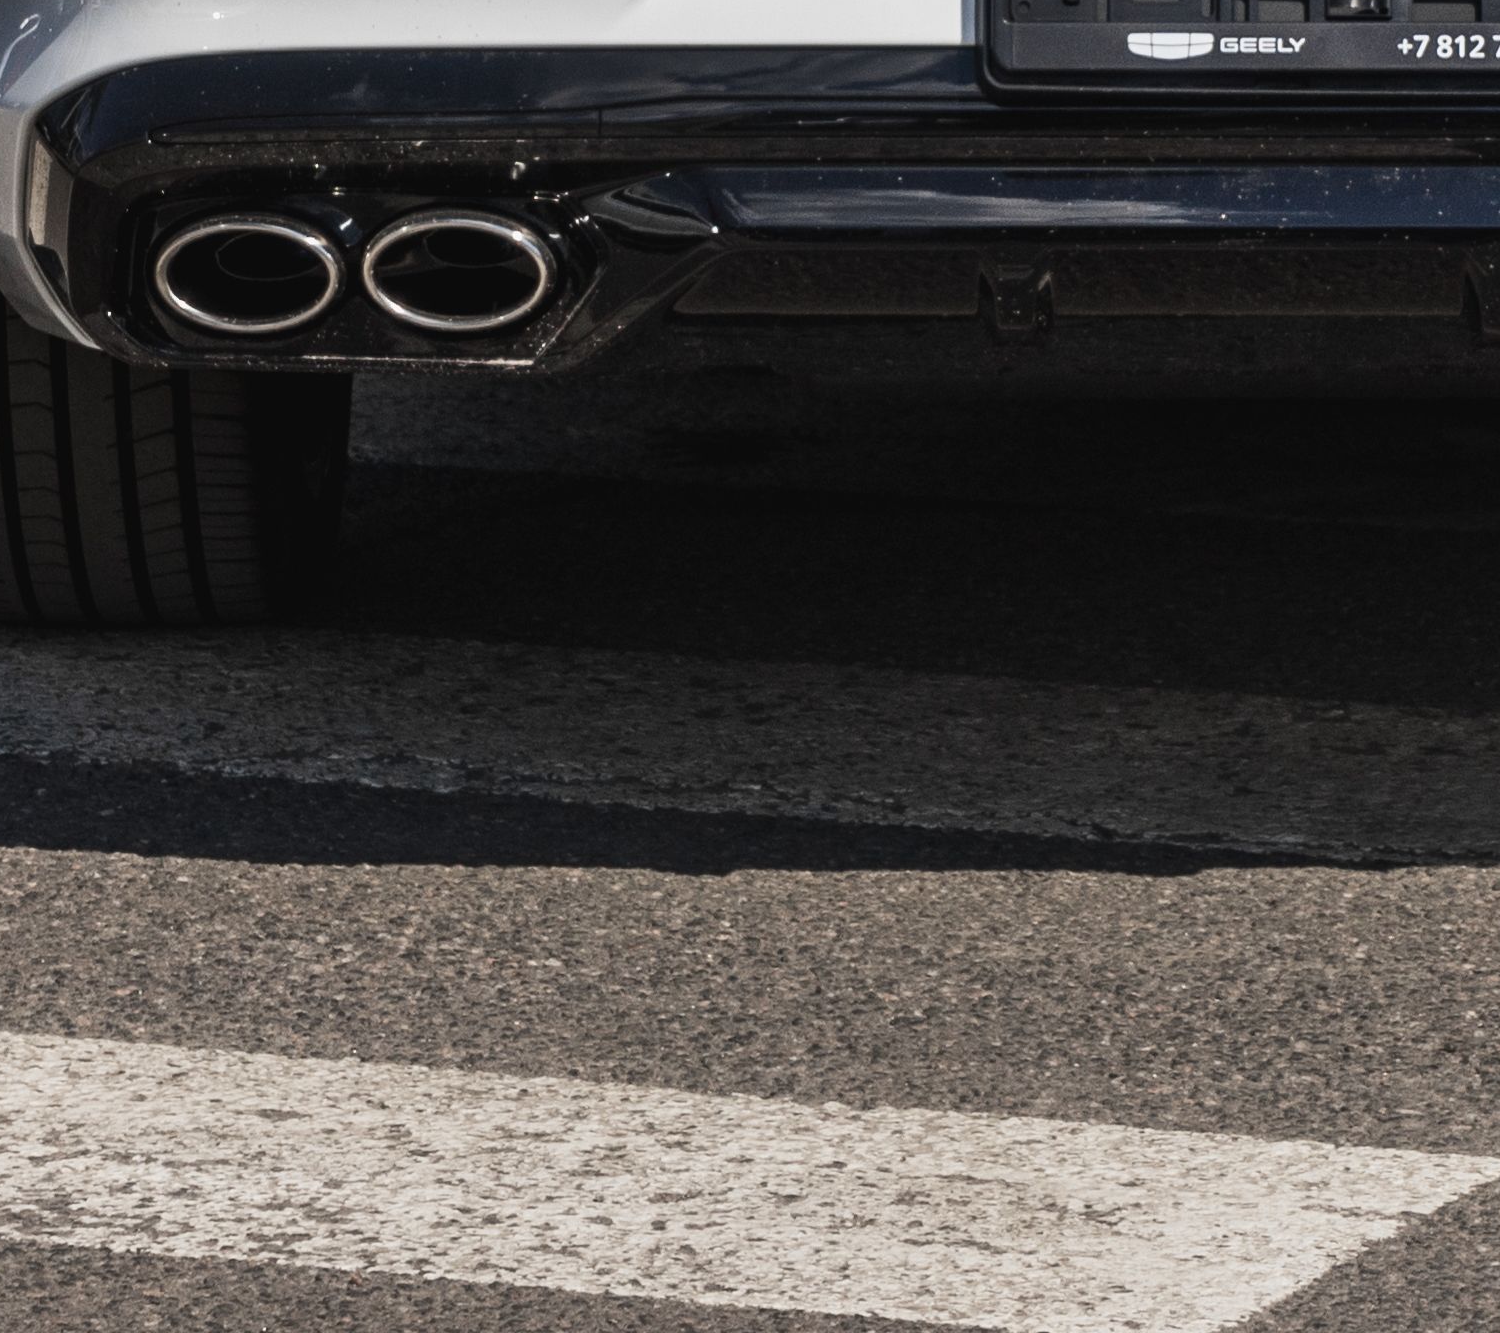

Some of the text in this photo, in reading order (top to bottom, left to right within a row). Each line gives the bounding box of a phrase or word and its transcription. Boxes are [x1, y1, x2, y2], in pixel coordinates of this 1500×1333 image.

[1220, 37, 1306, 53] GEELY
[1397, 35, 1430, 58] +7
[1437, 35, 1486, 58] 812
